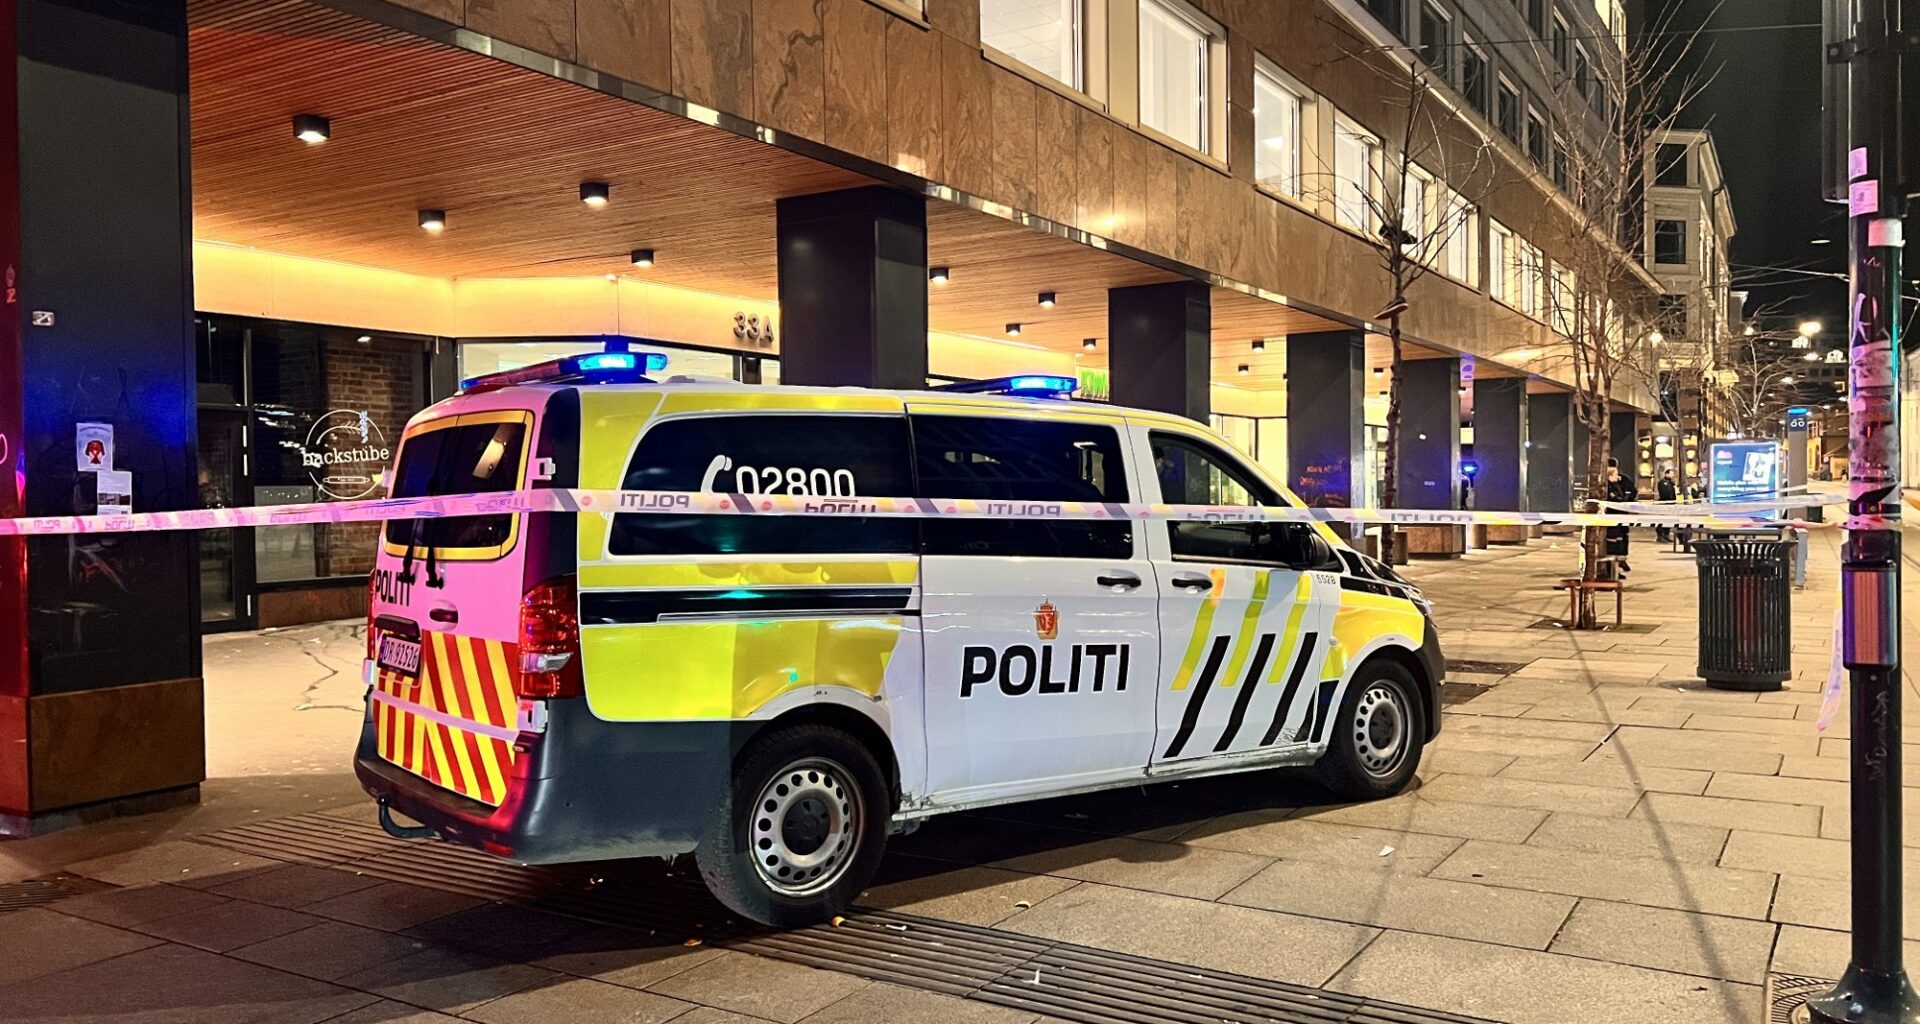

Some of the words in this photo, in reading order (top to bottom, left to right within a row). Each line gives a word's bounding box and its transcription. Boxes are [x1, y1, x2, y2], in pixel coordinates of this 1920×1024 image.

[733, 311, 774, 345] 33A
[735, 465, 855, 496] 02800
[395, 643, 418, 669] 92526
[960, 643, 1131, 698] POLITI
